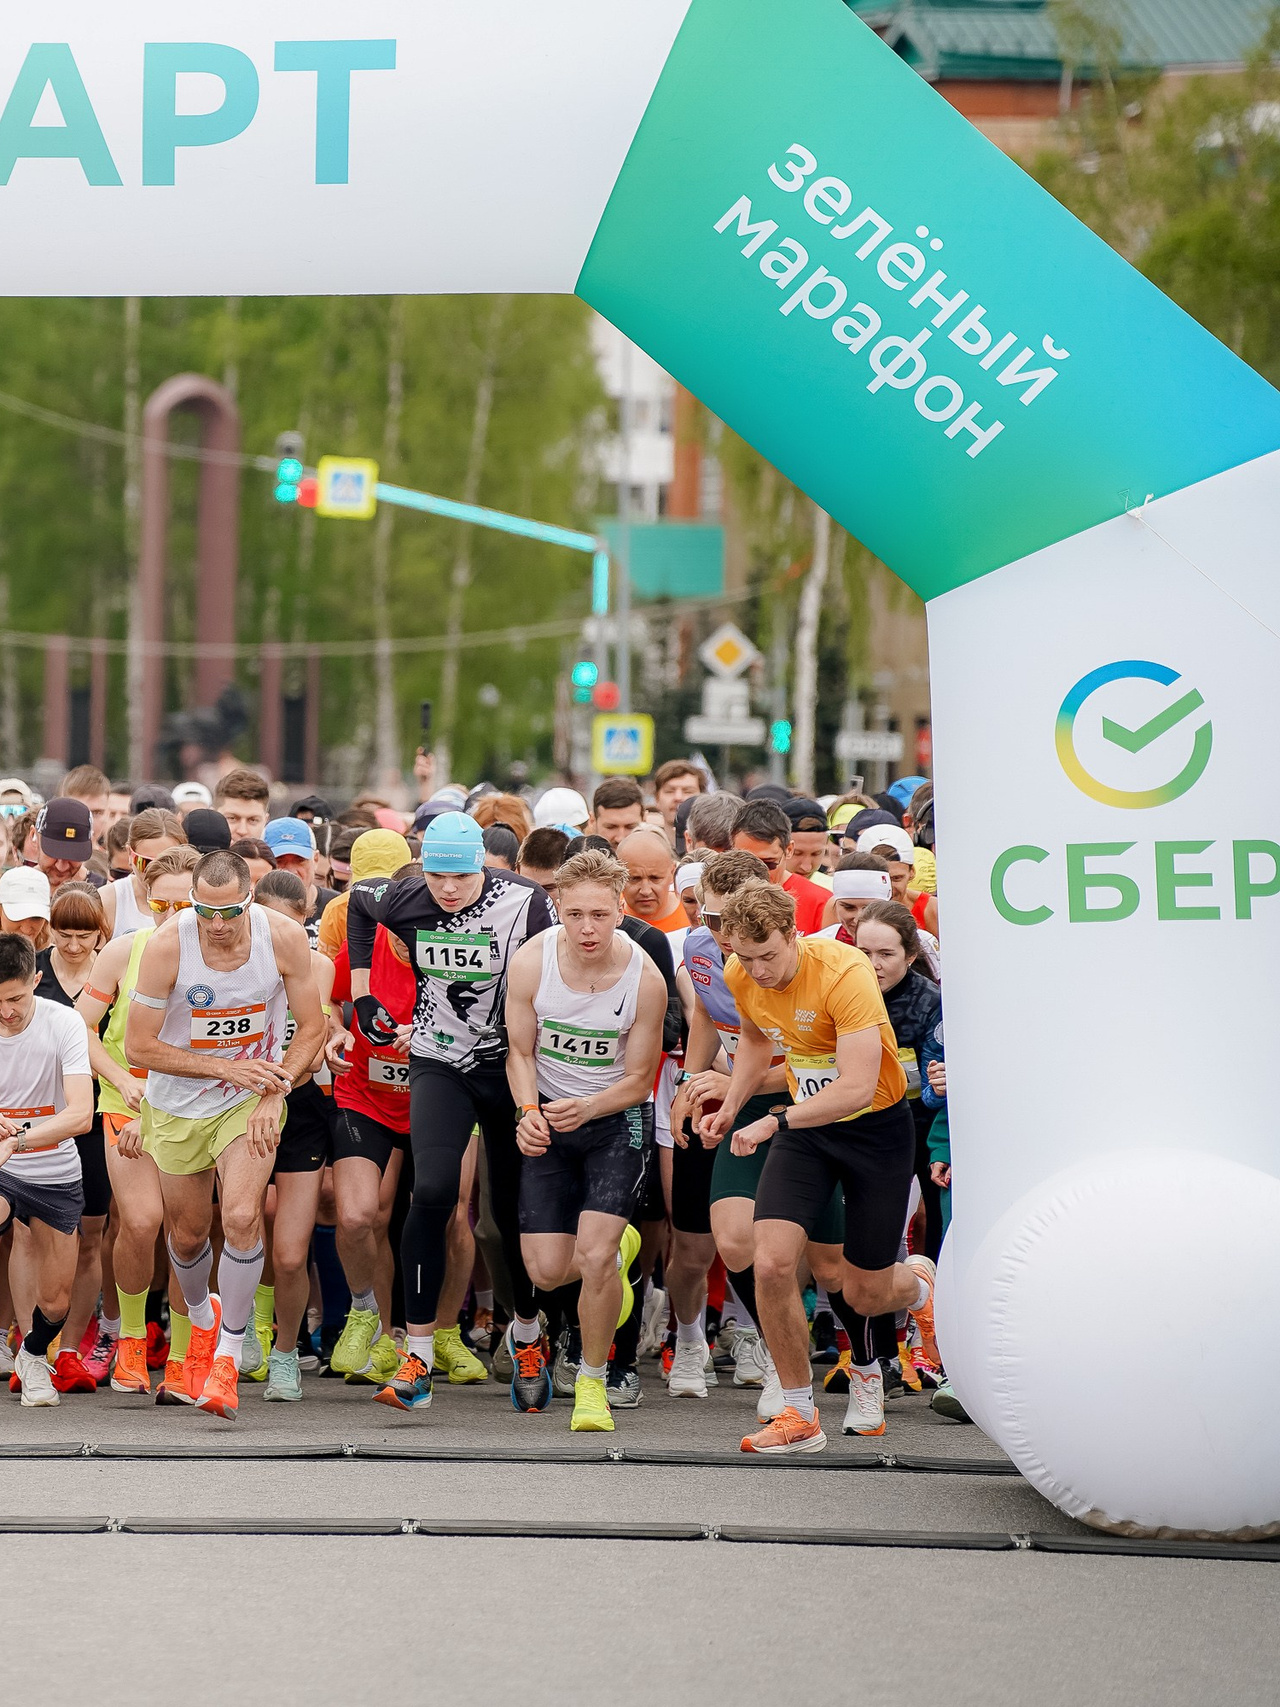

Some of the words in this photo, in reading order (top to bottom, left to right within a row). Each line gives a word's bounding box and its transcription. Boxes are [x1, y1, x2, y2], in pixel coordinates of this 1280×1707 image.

[767, 143, 1071, 406] зелёный
[713, 194, 1005, 459] марафон
[990, 839, 1280, 926] СБЕР
[425, 946, 483, 968] 1154
[207, 1018, 251, 1037] 238
[550, 1034, 609, 1056] 1415
